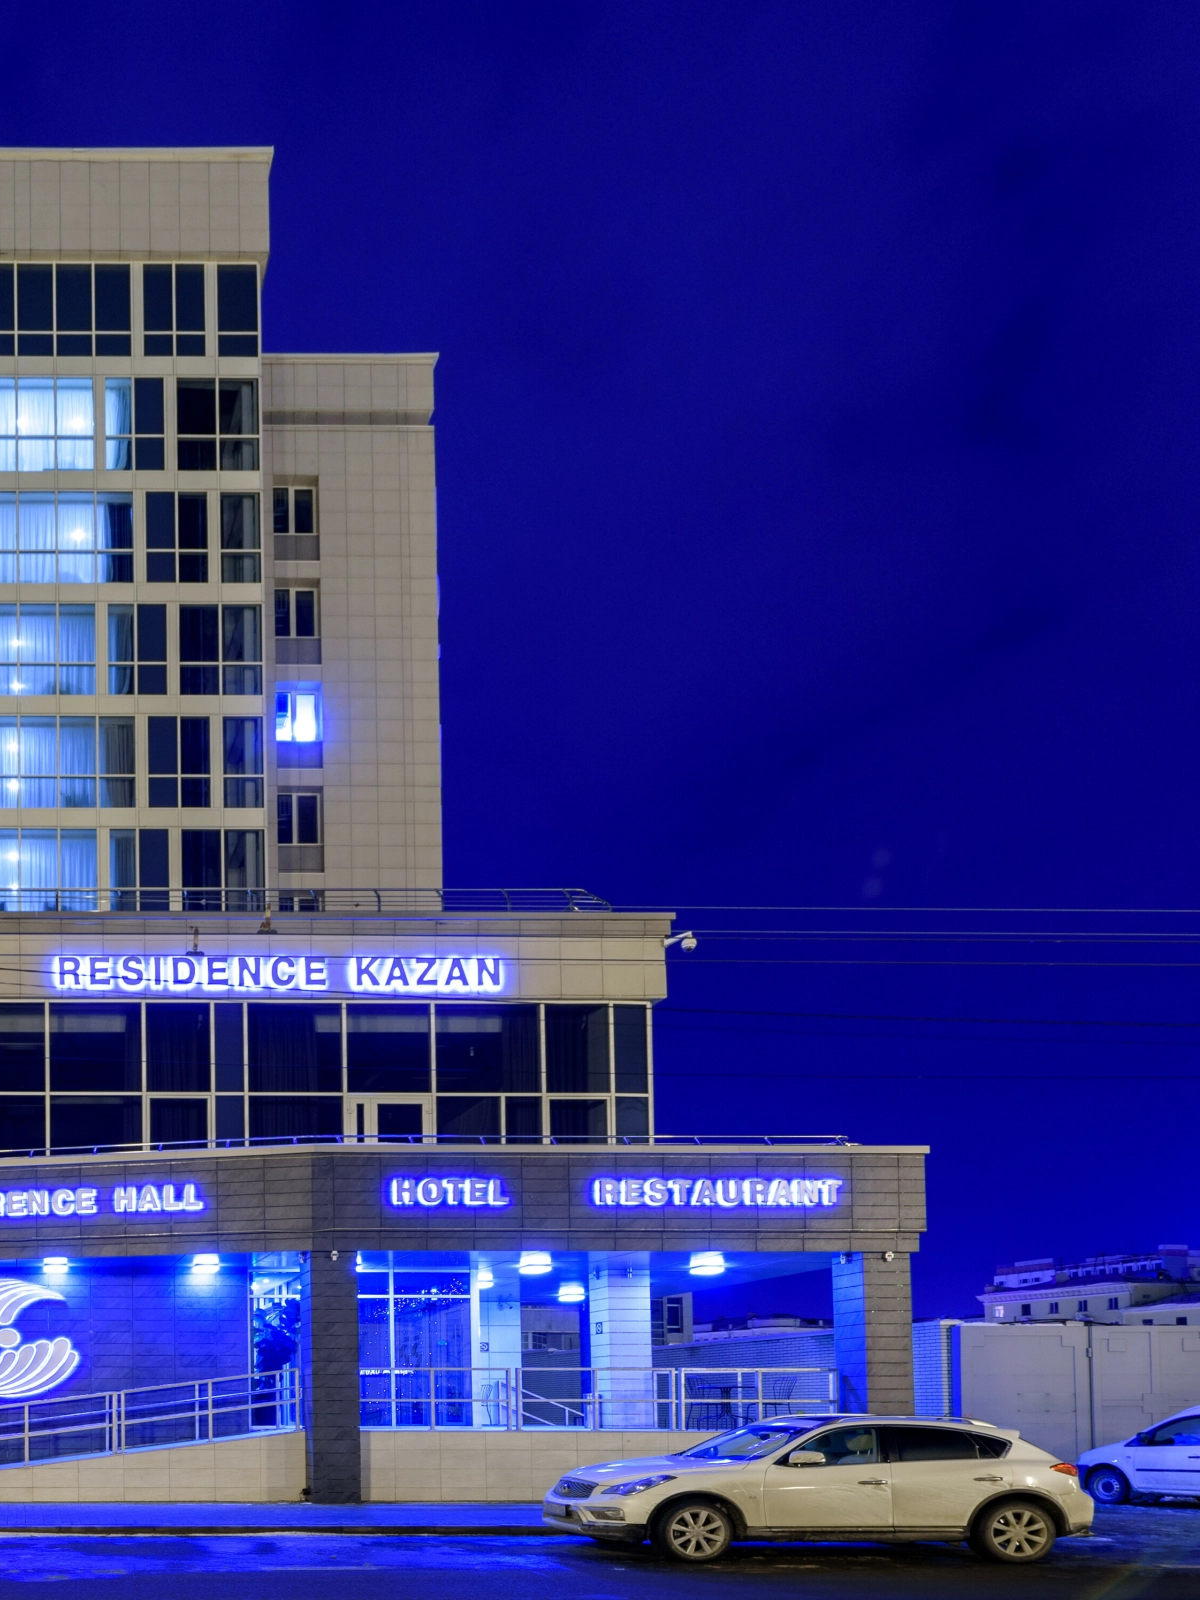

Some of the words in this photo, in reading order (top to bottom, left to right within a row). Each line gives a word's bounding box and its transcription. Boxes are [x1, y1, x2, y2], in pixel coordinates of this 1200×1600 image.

[57, 955, 327, 987] RESIDENCE
[353, 956, 502, 988] KAZAN
[114, 1183, 204, 1212] HALL
[391, 1178, 509, 1206] HOTEL
[593, 1178, 843, 1207] RESTAURANT
